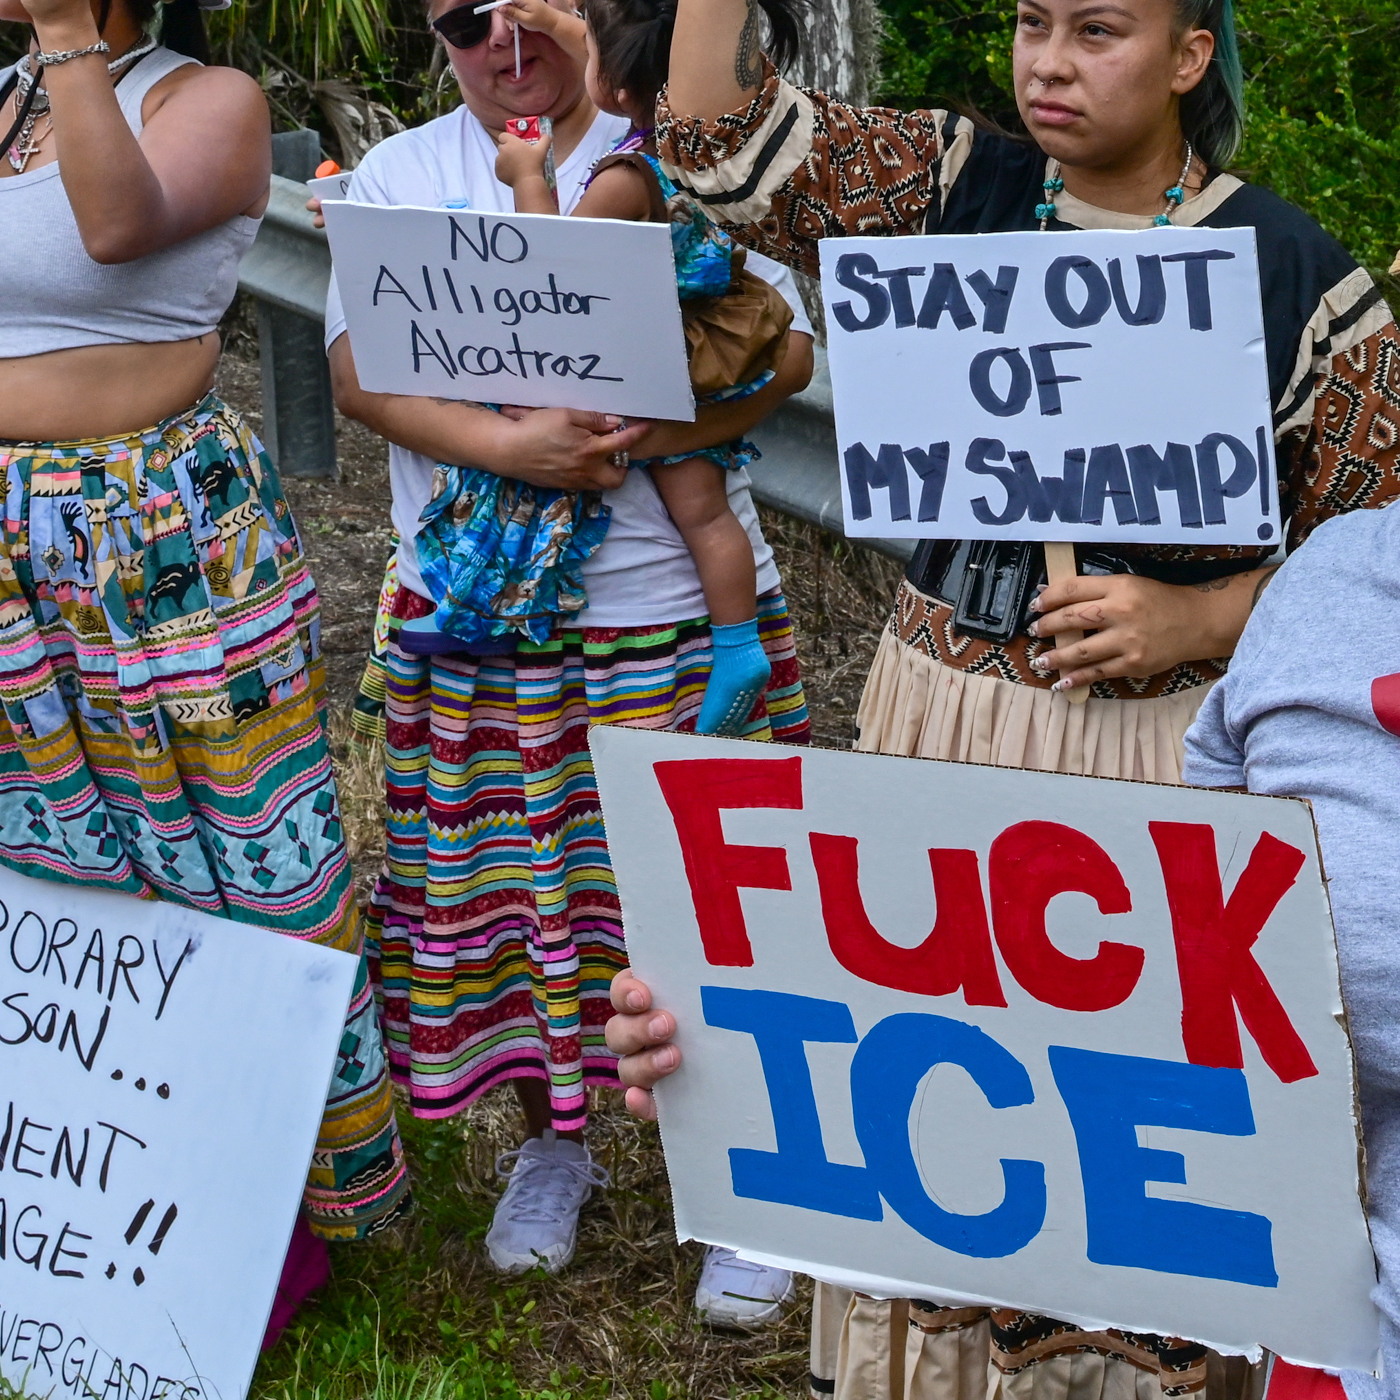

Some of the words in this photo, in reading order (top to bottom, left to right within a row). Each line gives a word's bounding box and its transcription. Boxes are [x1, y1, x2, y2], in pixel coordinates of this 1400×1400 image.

[448, 215, 528, 264] NO
[372, 264, 611, 326] Alligator
[831, 252, 1020, 334] STAY
[1044, 249, 1236, 331] OUT
[410, 319, 624, 382] Alcatraz
[968, 341, 1093, 417] OF
[843, 441, 950, 523] MY
[964, 425, 1274, 541] SWAMP!
[700, 985, 1279, 1288] ICE
